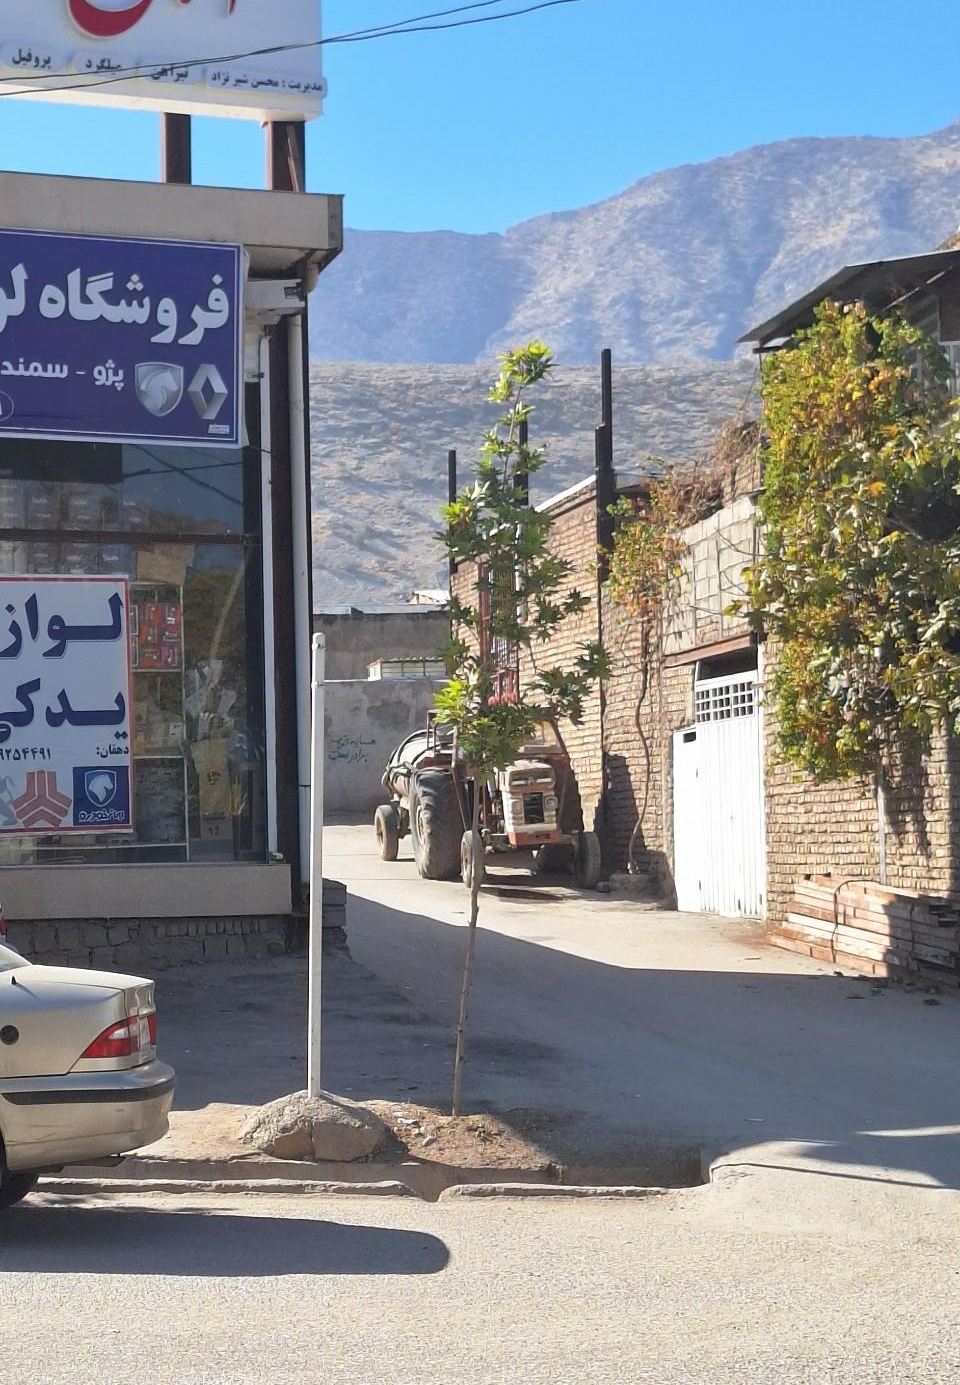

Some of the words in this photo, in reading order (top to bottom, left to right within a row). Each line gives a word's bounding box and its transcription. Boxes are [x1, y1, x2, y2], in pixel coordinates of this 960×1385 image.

[38, 267, 230, 346] فروشگاه
[0, 354, 69, 379] سمند
[92, 359, 125, 391] پژو
